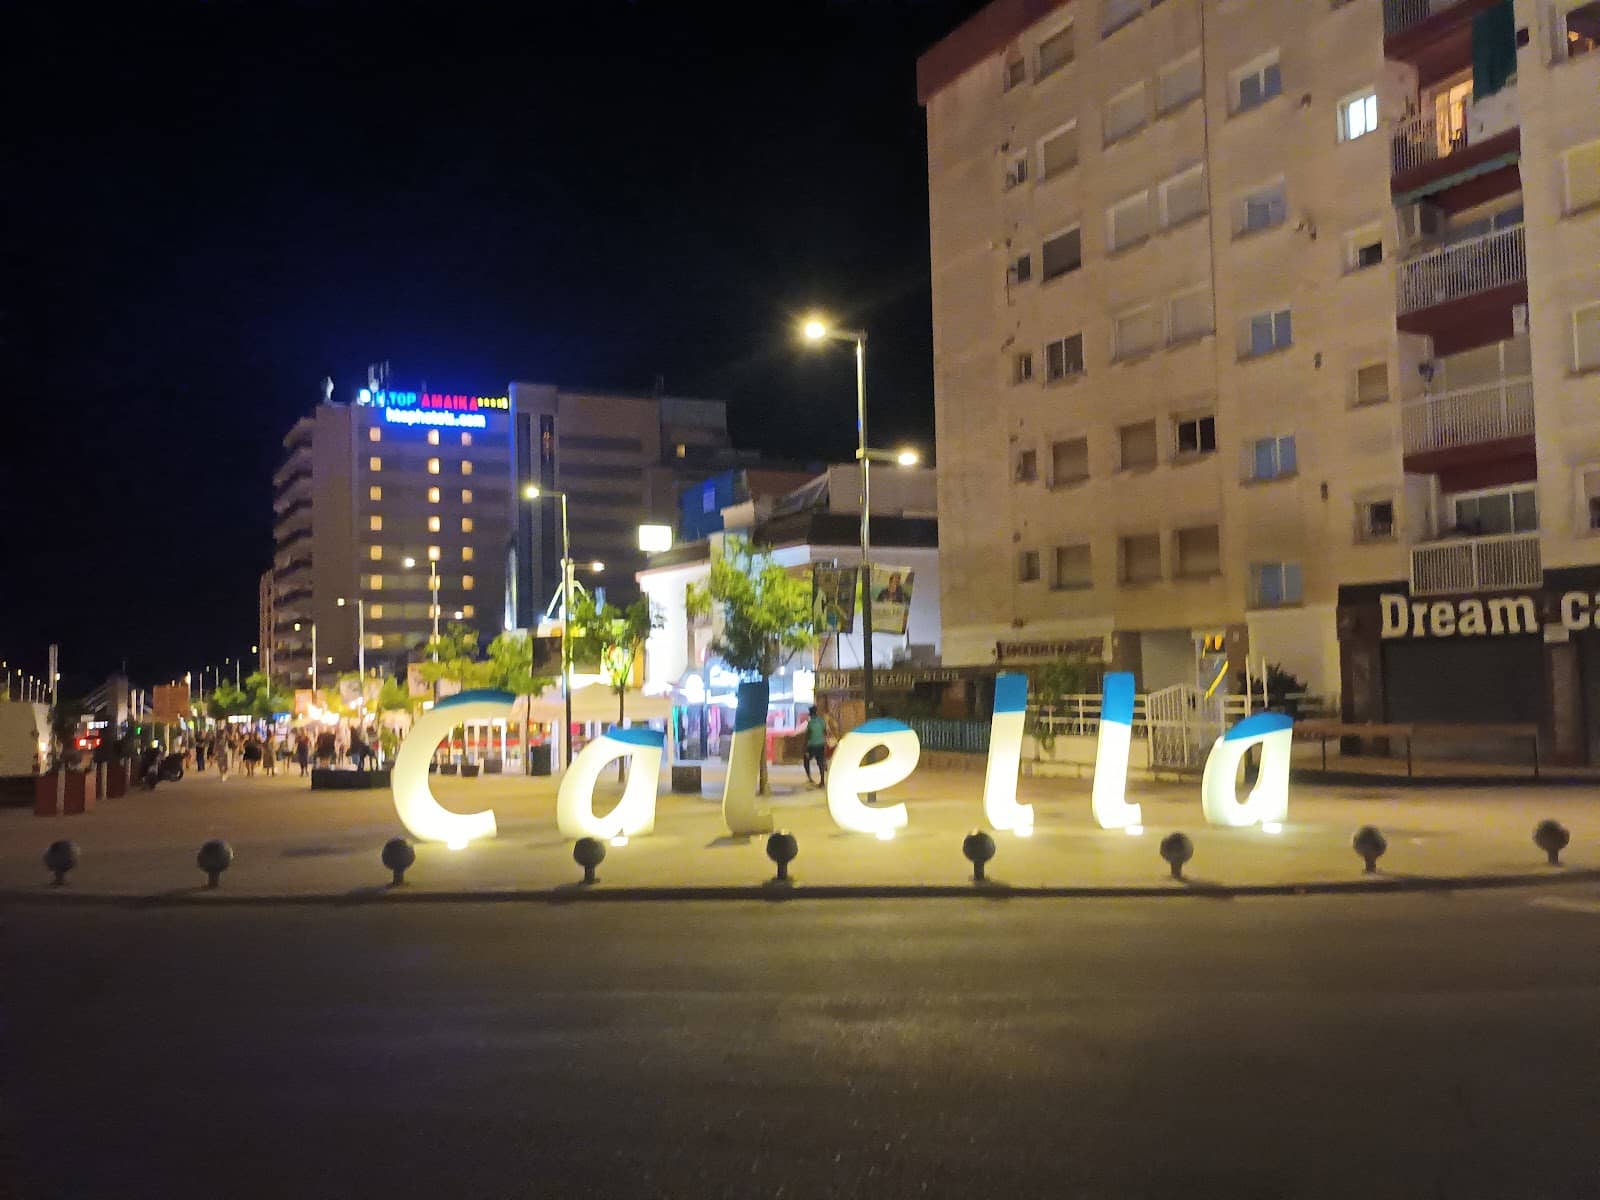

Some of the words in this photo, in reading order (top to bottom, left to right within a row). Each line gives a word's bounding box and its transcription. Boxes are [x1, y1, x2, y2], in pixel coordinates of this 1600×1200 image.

[421, 393, 478, 411] AMAIKA
[1379, 592, 1539, 639] Dream
[392, 671, 1294, 844] Calella
